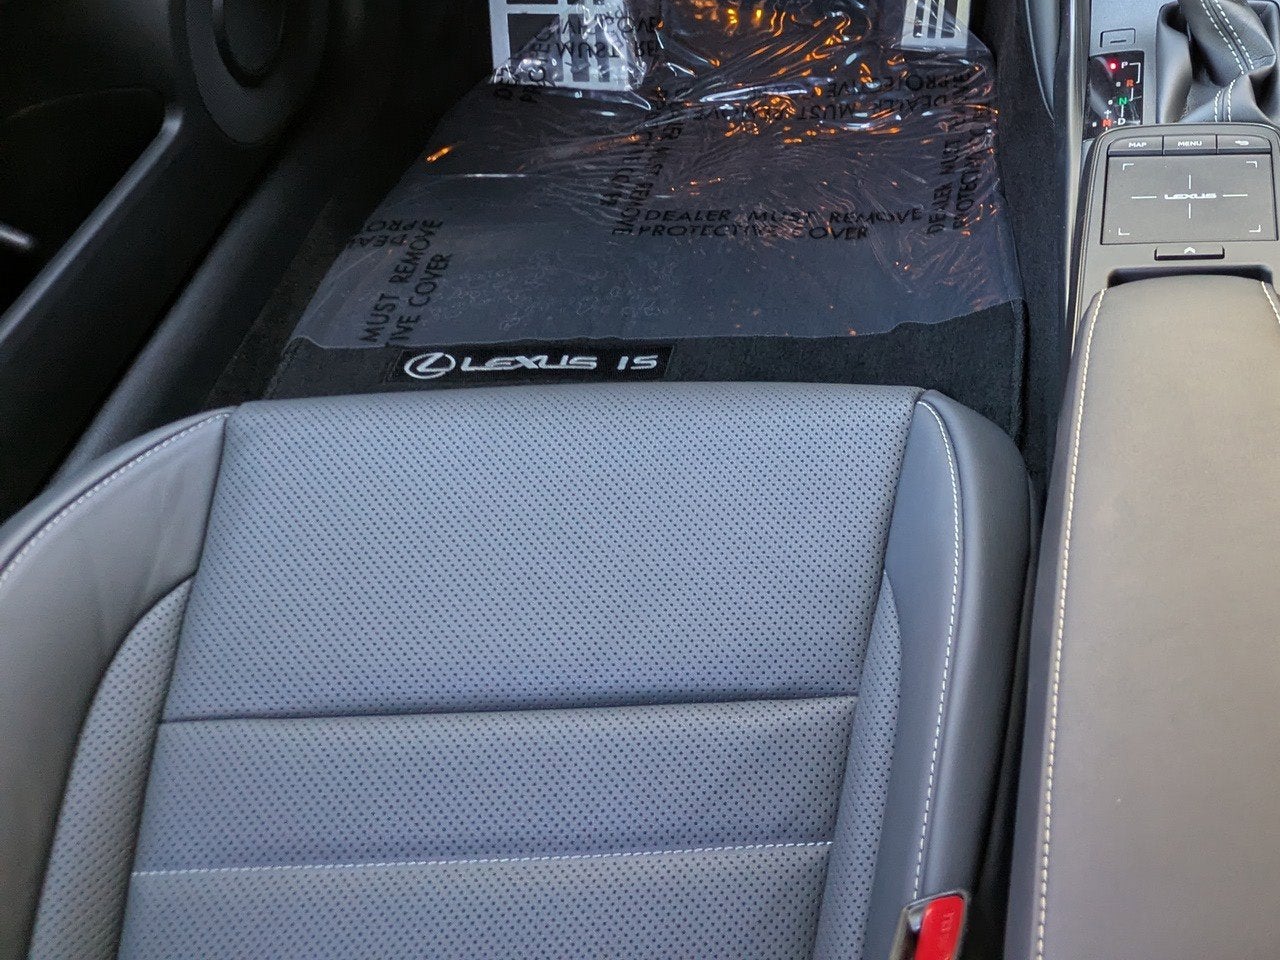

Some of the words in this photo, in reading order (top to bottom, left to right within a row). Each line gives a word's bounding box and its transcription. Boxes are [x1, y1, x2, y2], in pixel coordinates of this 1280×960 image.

[1118, 97, 1127, 105] N
[644, 209, 731, 222] DEALER
[360, 292, 400, 342] MUST
[388, 220, 443, 283] REMOVE
[408, 253, 454, 307] COVER
[461, 354, 597, 372] LEXUS
[616, 354, 658, 371] IS
